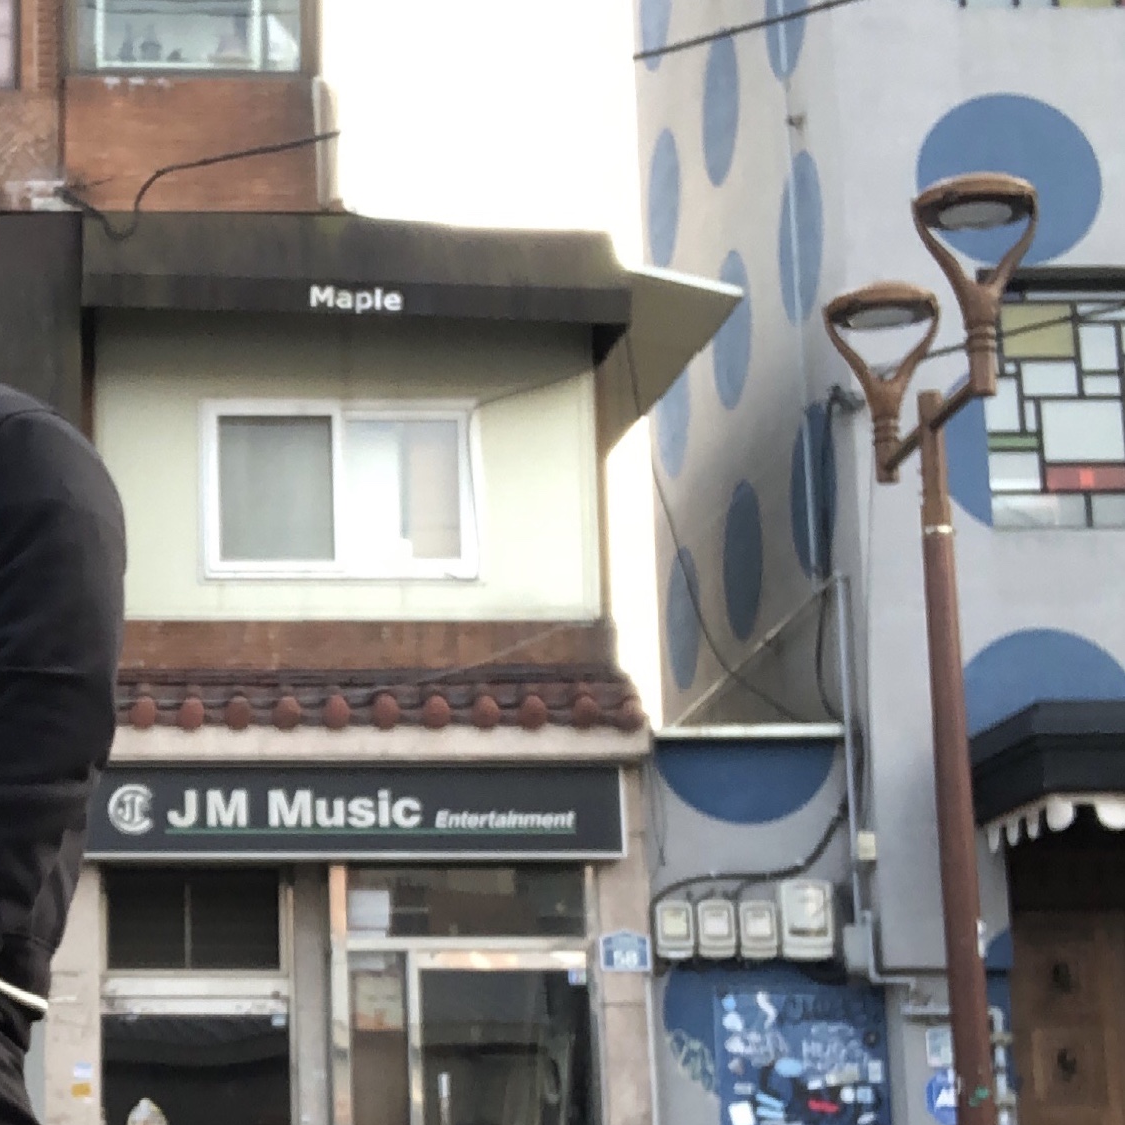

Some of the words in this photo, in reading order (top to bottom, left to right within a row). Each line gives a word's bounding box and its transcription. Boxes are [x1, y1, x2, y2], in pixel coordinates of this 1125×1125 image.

[310, 285, 402, 313] Maple
[168, 789, 248, 828] JM
[268, 789, 422, 828] Music
[435, 810, 574, 829] Entertainment
